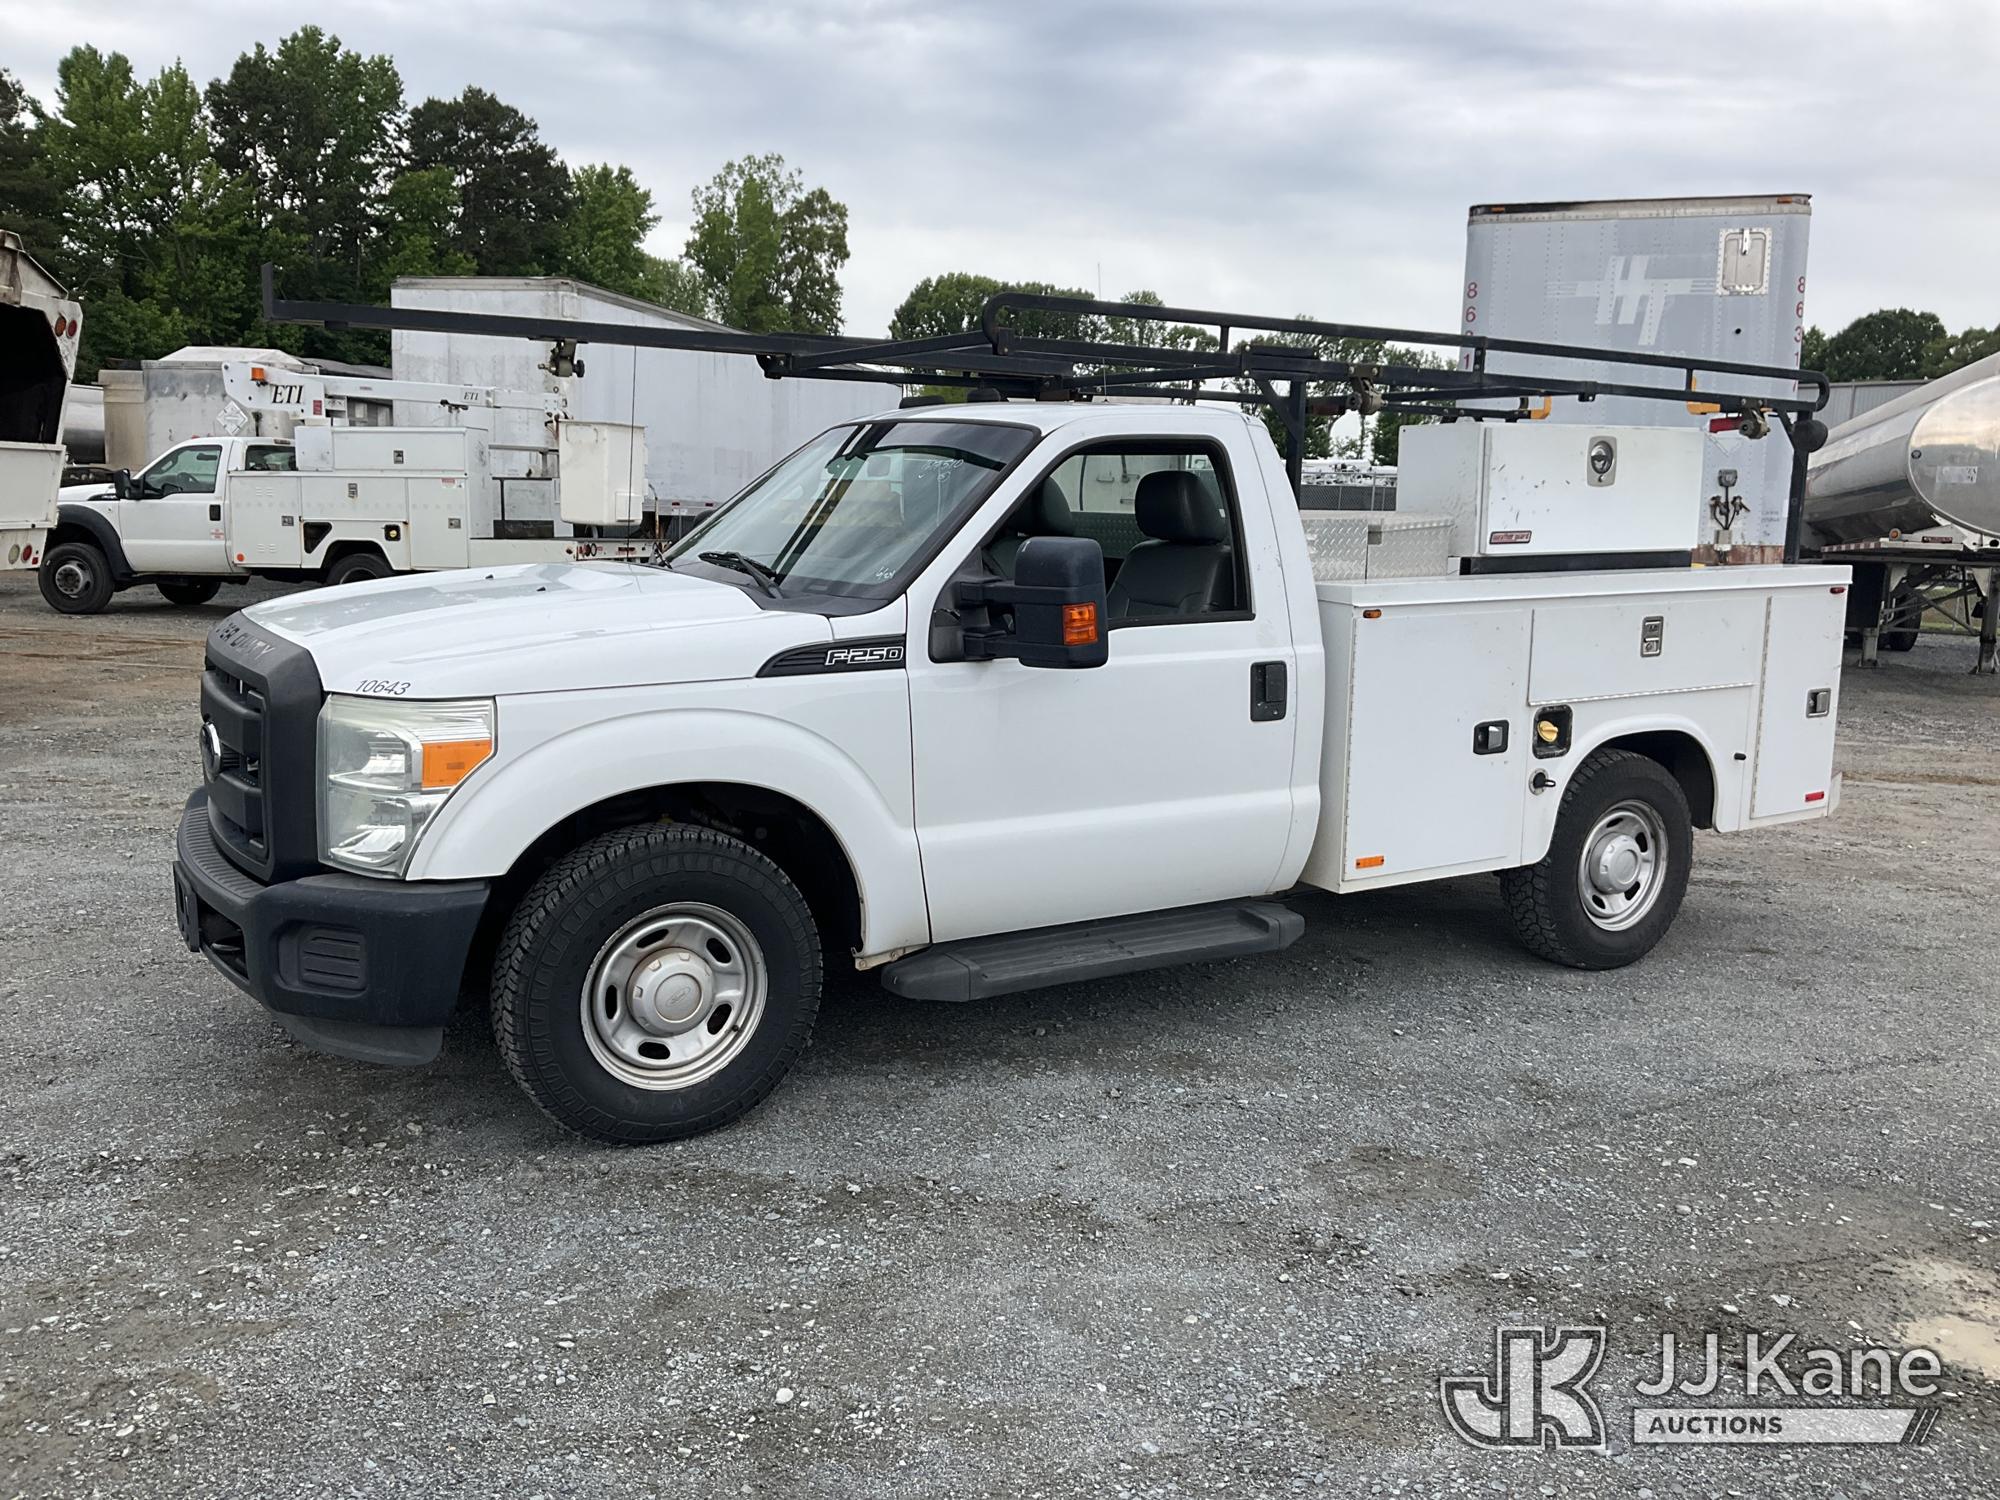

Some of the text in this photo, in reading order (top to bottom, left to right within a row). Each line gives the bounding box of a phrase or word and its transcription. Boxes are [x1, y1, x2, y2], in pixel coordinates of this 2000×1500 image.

[272, 385, 304, 404] ETI
[463, 391, 480, 401] ETI
[825, 646, 904, 666] F-250
[355, 679, 411, 696] 10643
